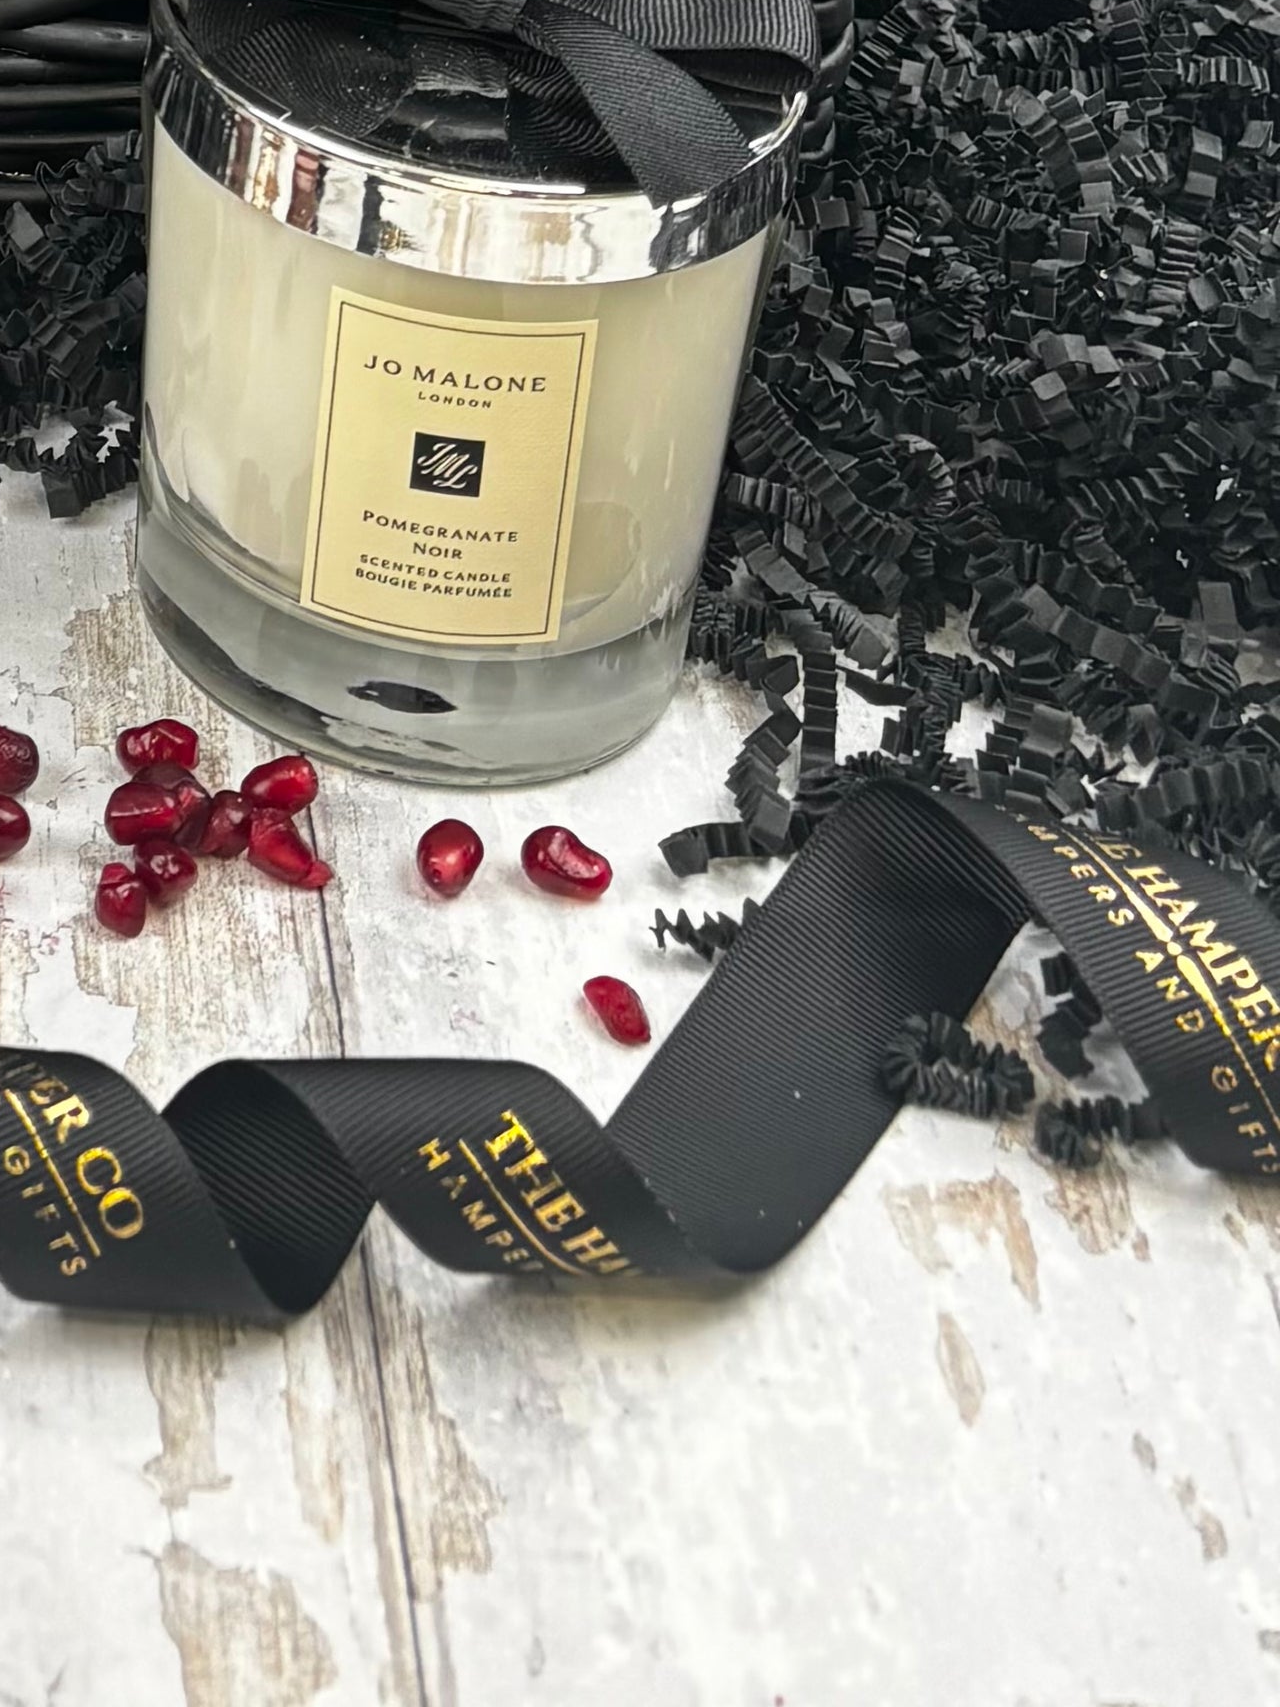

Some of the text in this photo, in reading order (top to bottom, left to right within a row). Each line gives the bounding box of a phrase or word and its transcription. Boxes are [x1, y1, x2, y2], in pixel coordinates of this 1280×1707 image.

[364, 355, 547, 393] JO MALONE
[418, 391, 493, 409] LONDON
[362, 509, 519, 543] POMEGRANATE
[412, 541, 463, 560] NOIR
[355, 567, 513, 598] BOUGIE PARFUMÉE
[359, 553, 511, 584] SCENTED CANDLE
[1135, 950, 1205, 1034] AND
[76, 1146, 144, 1240] CO
[2, 1145, 89, 1276] GIFTS
